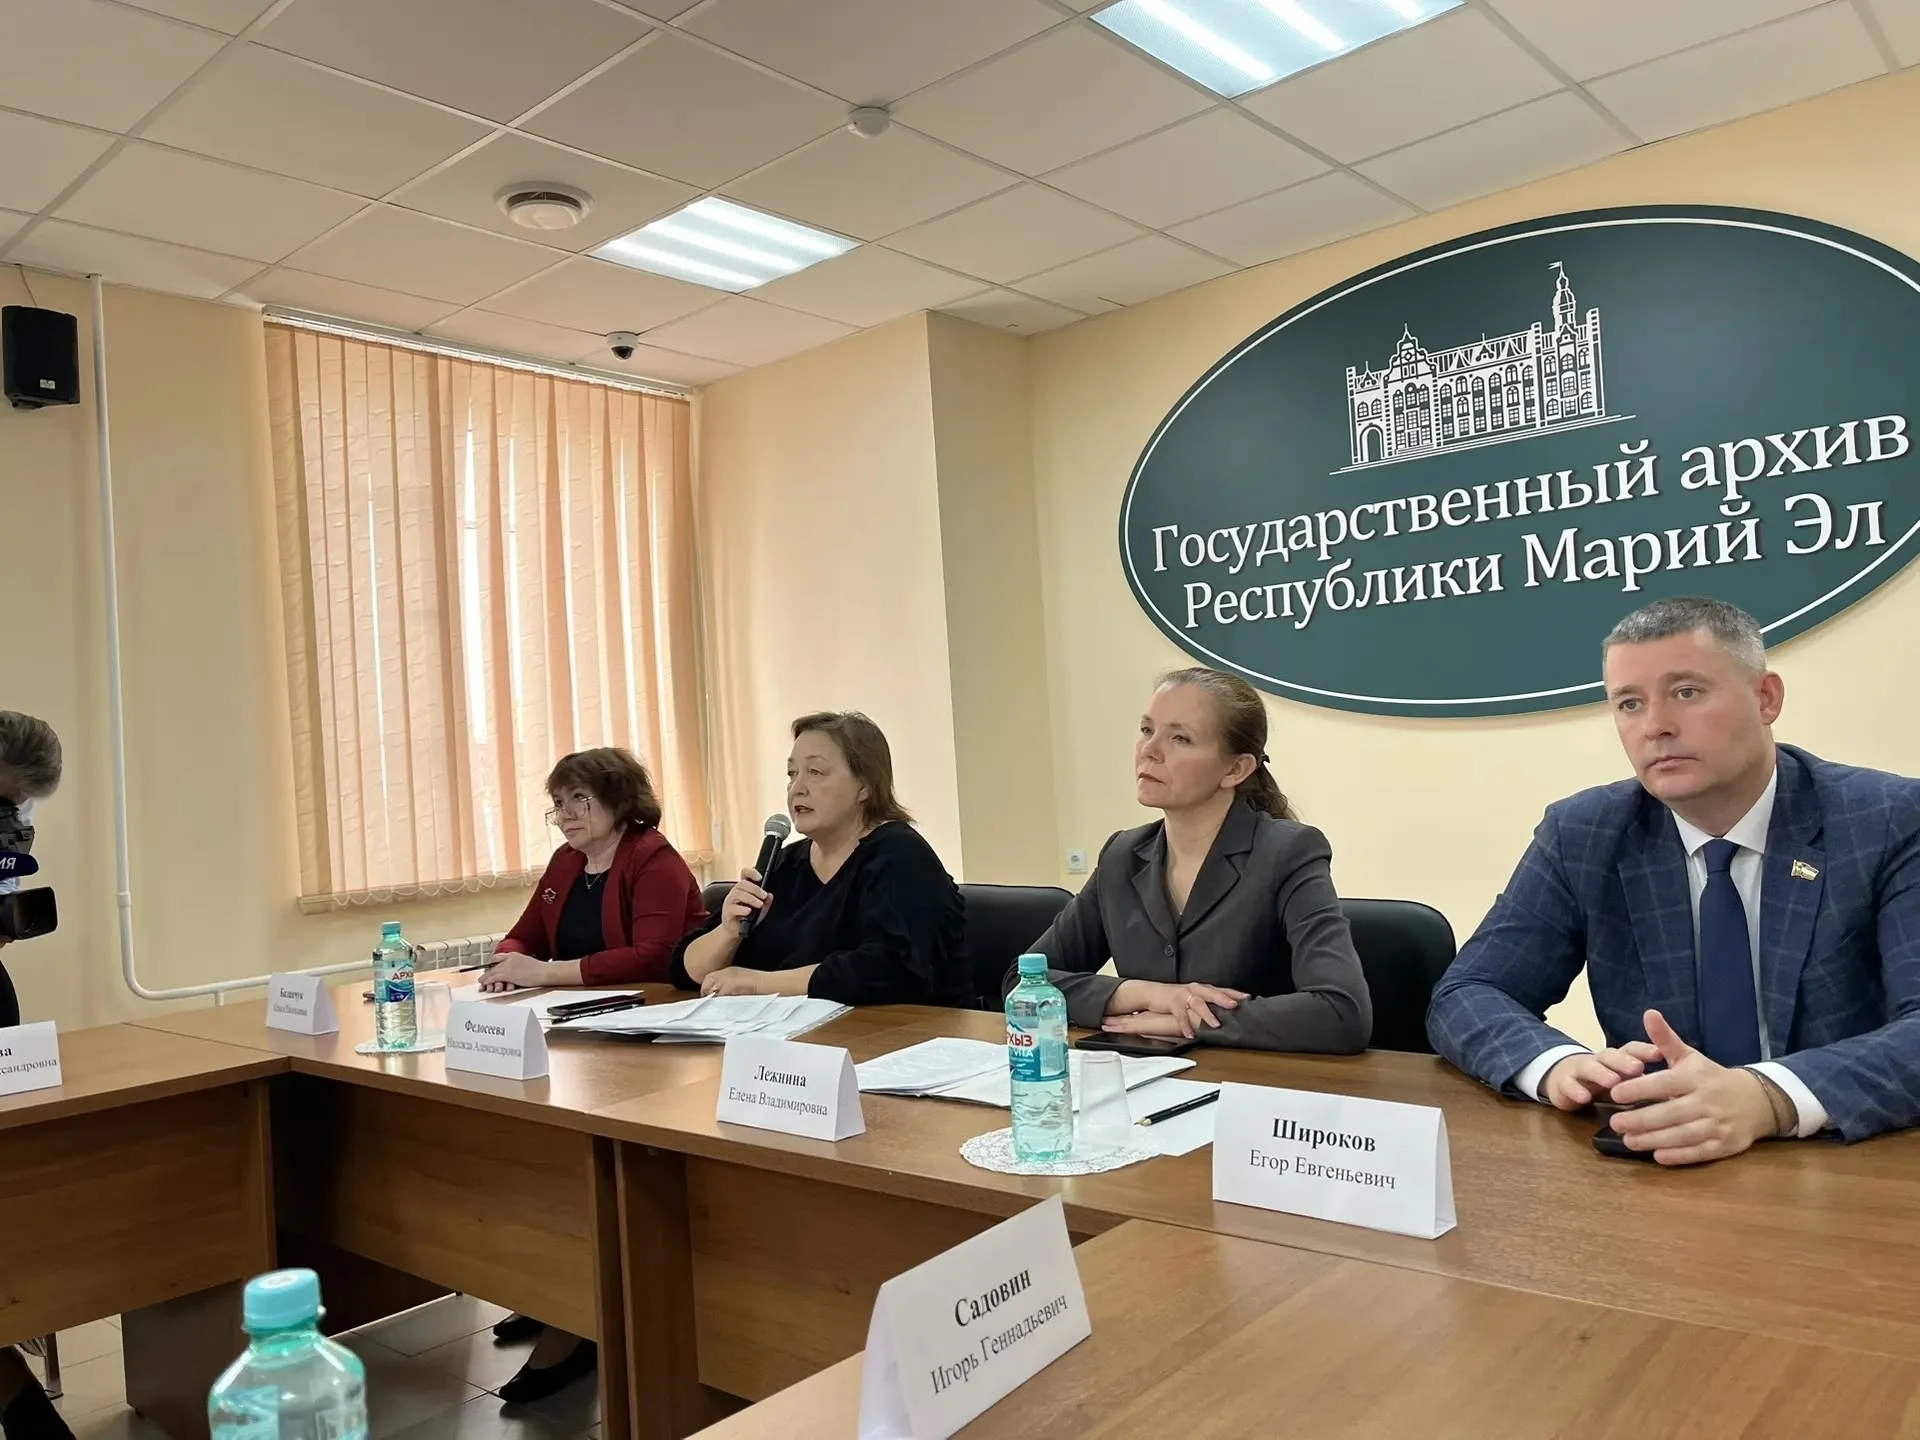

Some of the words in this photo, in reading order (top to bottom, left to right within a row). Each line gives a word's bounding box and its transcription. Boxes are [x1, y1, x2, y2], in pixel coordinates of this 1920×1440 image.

[1151, 438, 1660, 575] Государственный
[1680, 414, 1910, 502] архив
[1183, 553, 1504, 630] Республики
[1521, 500, 1763, 593] Марий
[1784, 492, 1886, 555] Эл
[1007, 1032, 1033, 1047] ХЫЗ
[0, 1059, 57, 1075] сандровна
[754, 1065, 806, 1087] Лежнина
[729, 1087, 756, 1104] Елена
[758, 1091, 828, 1116] Владимировна
[1272, 1118, 1376, 1152] Широков
[1249, 1149, 1290, 1176] Егор
[1295, 1156, 1396, 1190] Евгеньевич
[954, 1269, 1032, 1327] Садовин
[930, 1353, 979, 1395] Игорь
[980, 1295, 1068, 1361] Геннадьевич
